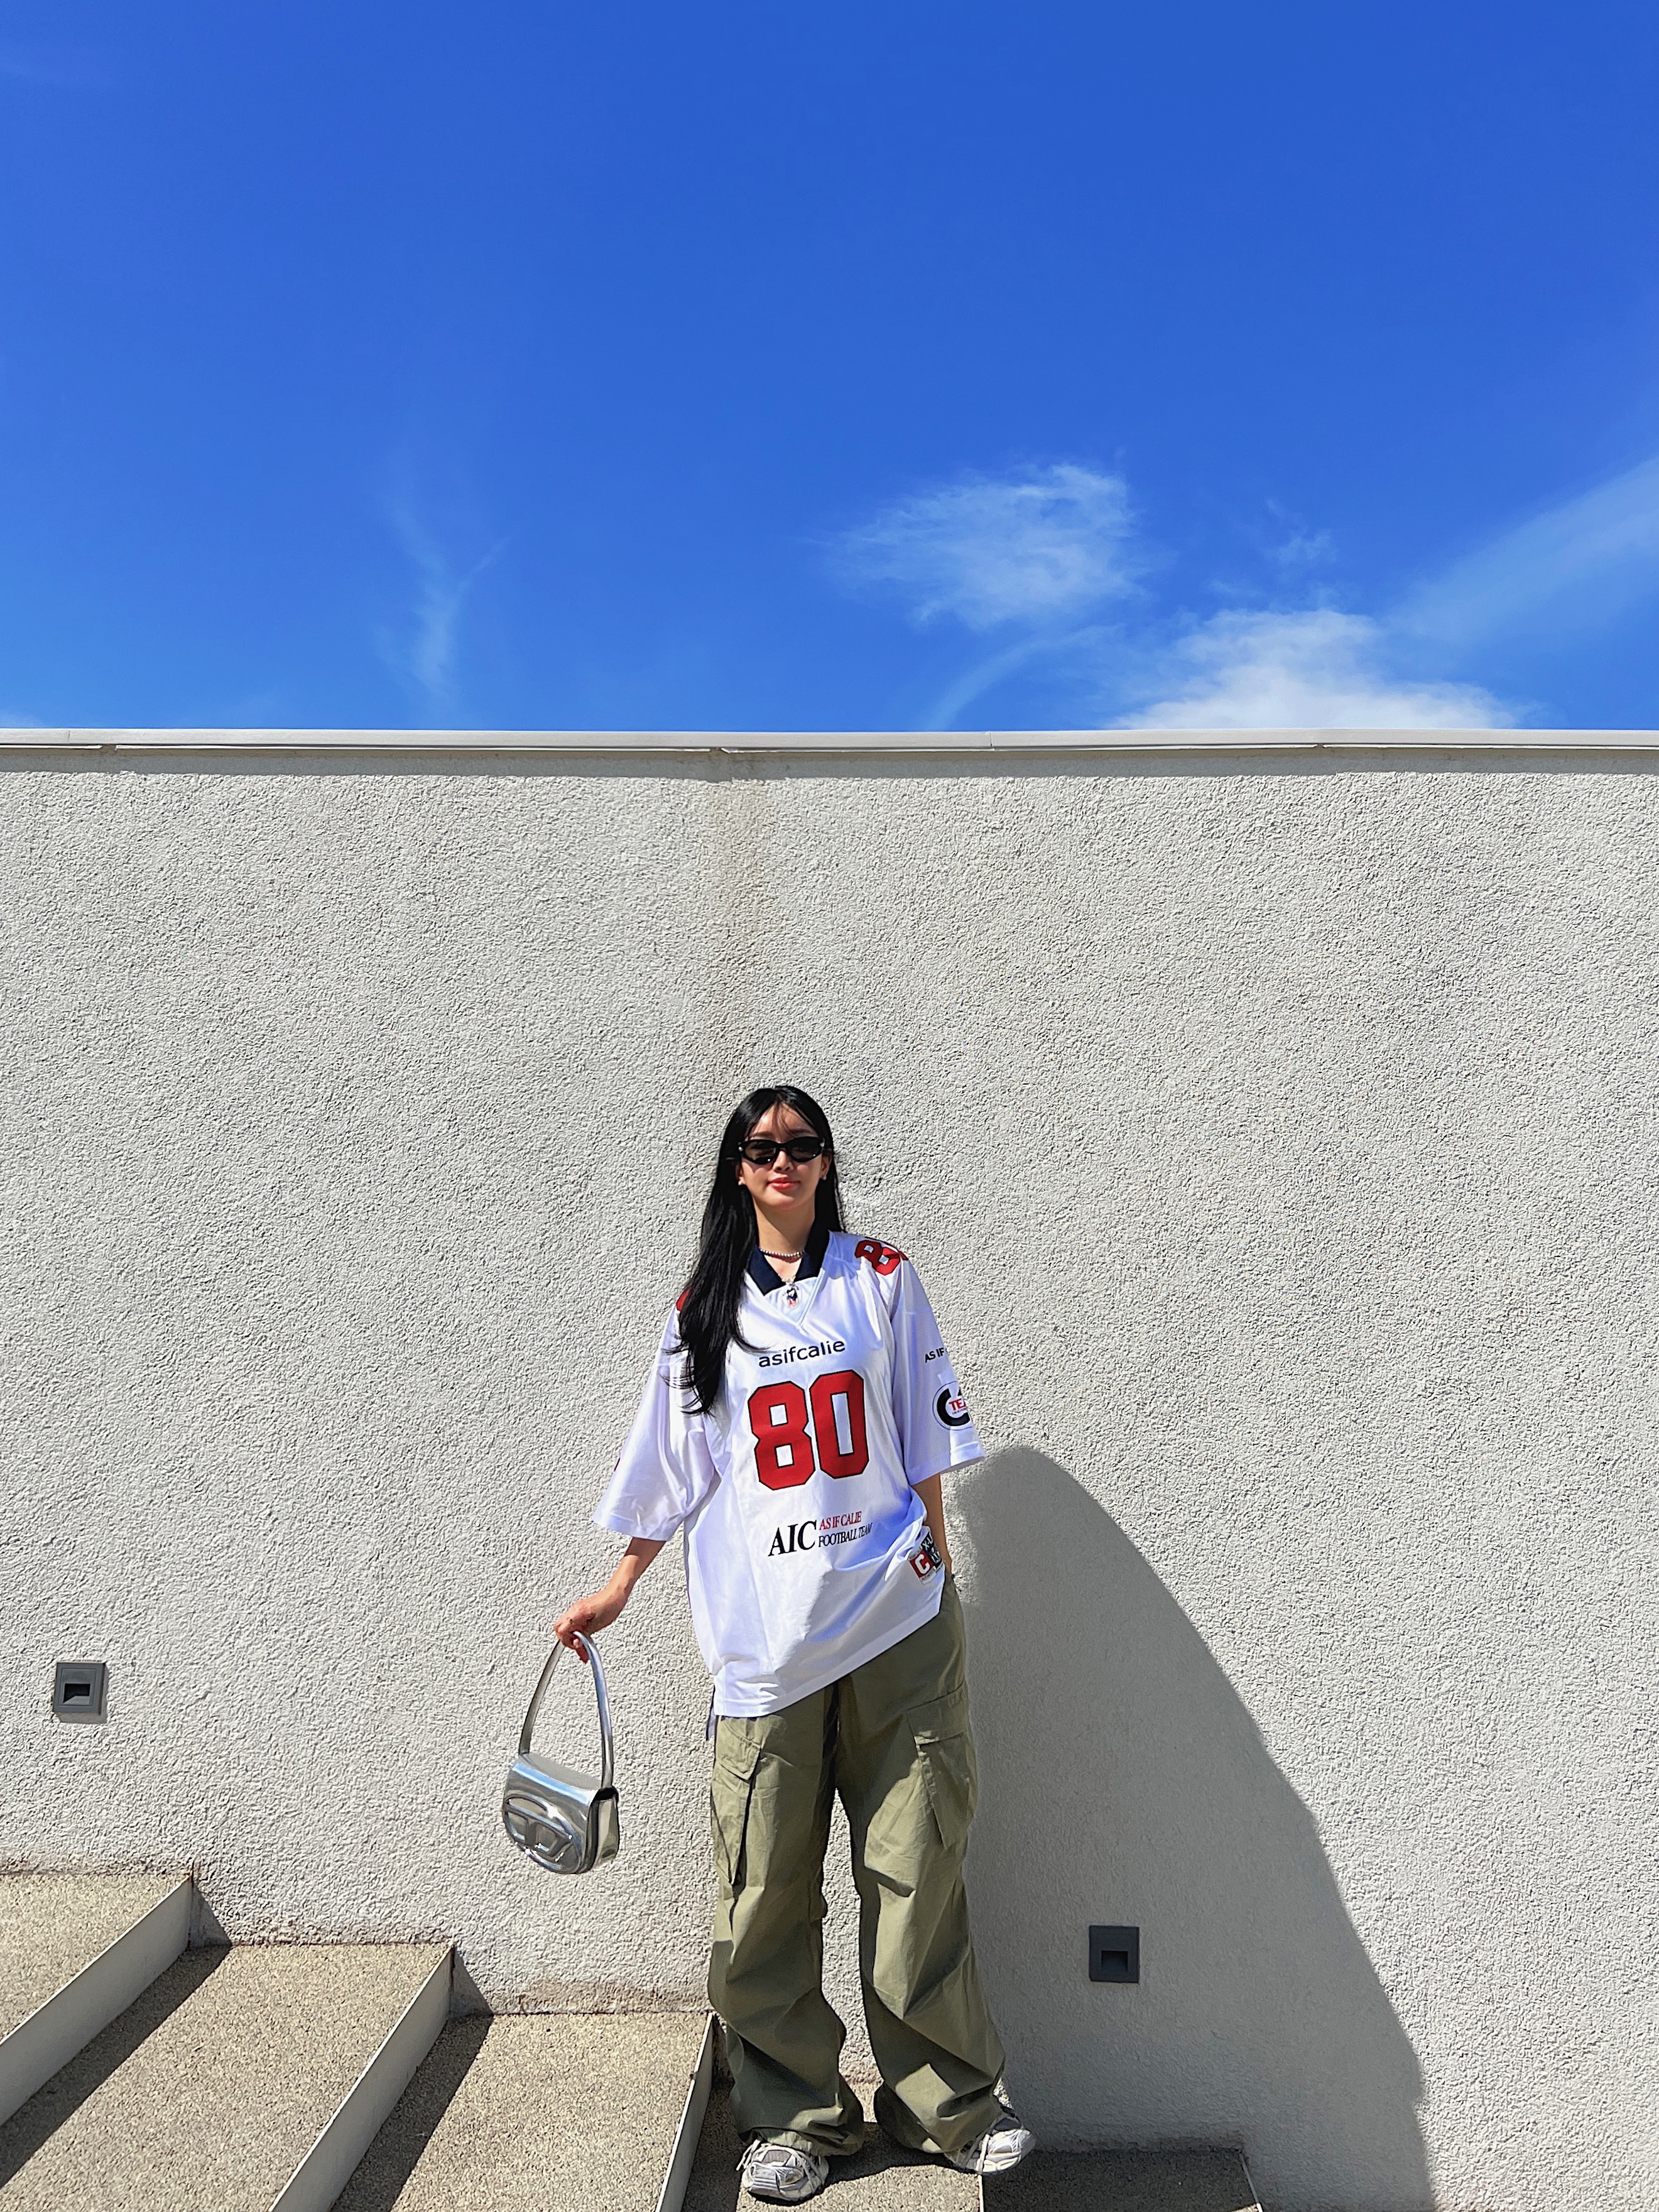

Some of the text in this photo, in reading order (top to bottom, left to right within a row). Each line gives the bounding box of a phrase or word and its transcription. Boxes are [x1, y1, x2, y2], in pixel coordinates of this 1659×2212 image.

[758, 1341, 846, 1367] asifcalie
[925, 1351, 936, 1363] AS
[936, 1348, 944, 1357] IF
[748, 1370, 869, 1490] 80
[819, 1511, 862, 1531] AS IF CALIE
[768, 1520, 817, 1557] AIC
[818, 1522, 873, 1547] FOOTBALL TEAM
[915, 1554, 930, 1574] C
